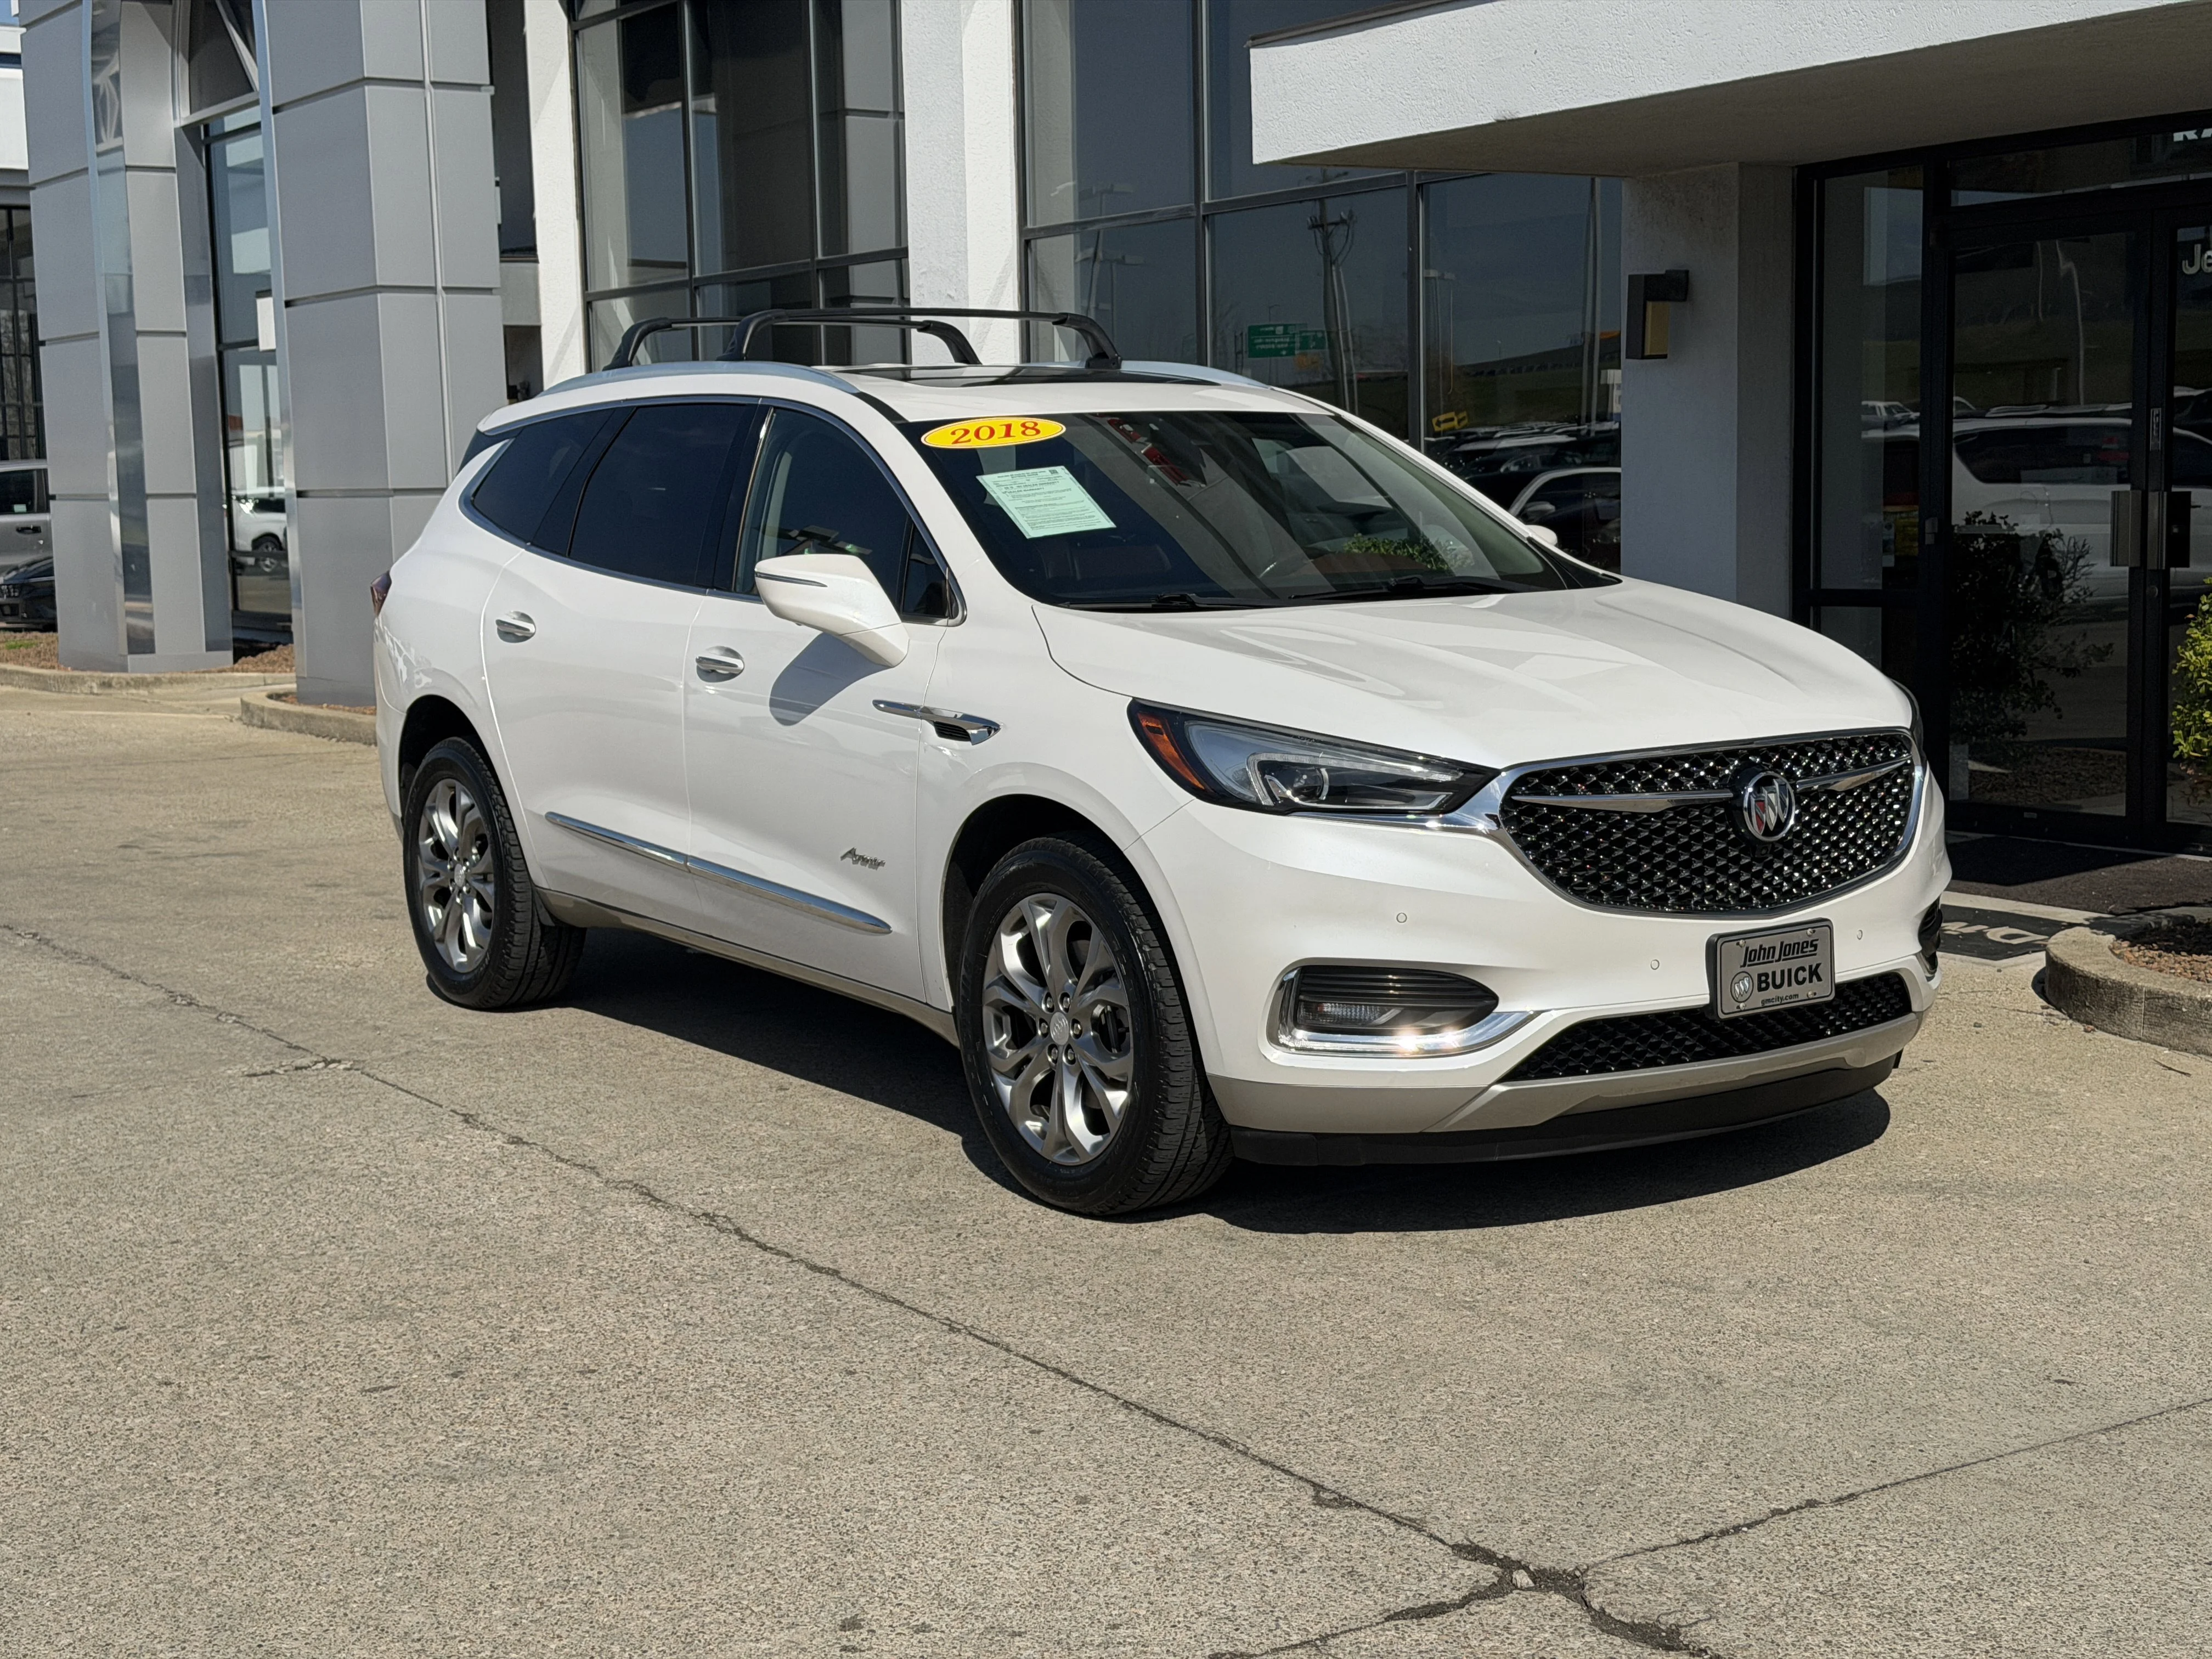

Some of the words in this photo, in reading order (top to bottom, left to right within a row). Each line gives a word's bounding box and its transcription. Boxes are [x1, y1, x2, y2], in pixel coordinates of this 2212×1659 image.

[950, 421, 1041, 445] 2018
[1740, 944, 1776, 968] John
[1774, 939, 1819, 962] Jones
[1757, 963, 1823, 992] BUICK
[1761, 994, 1799, 1006] gmcity.com
